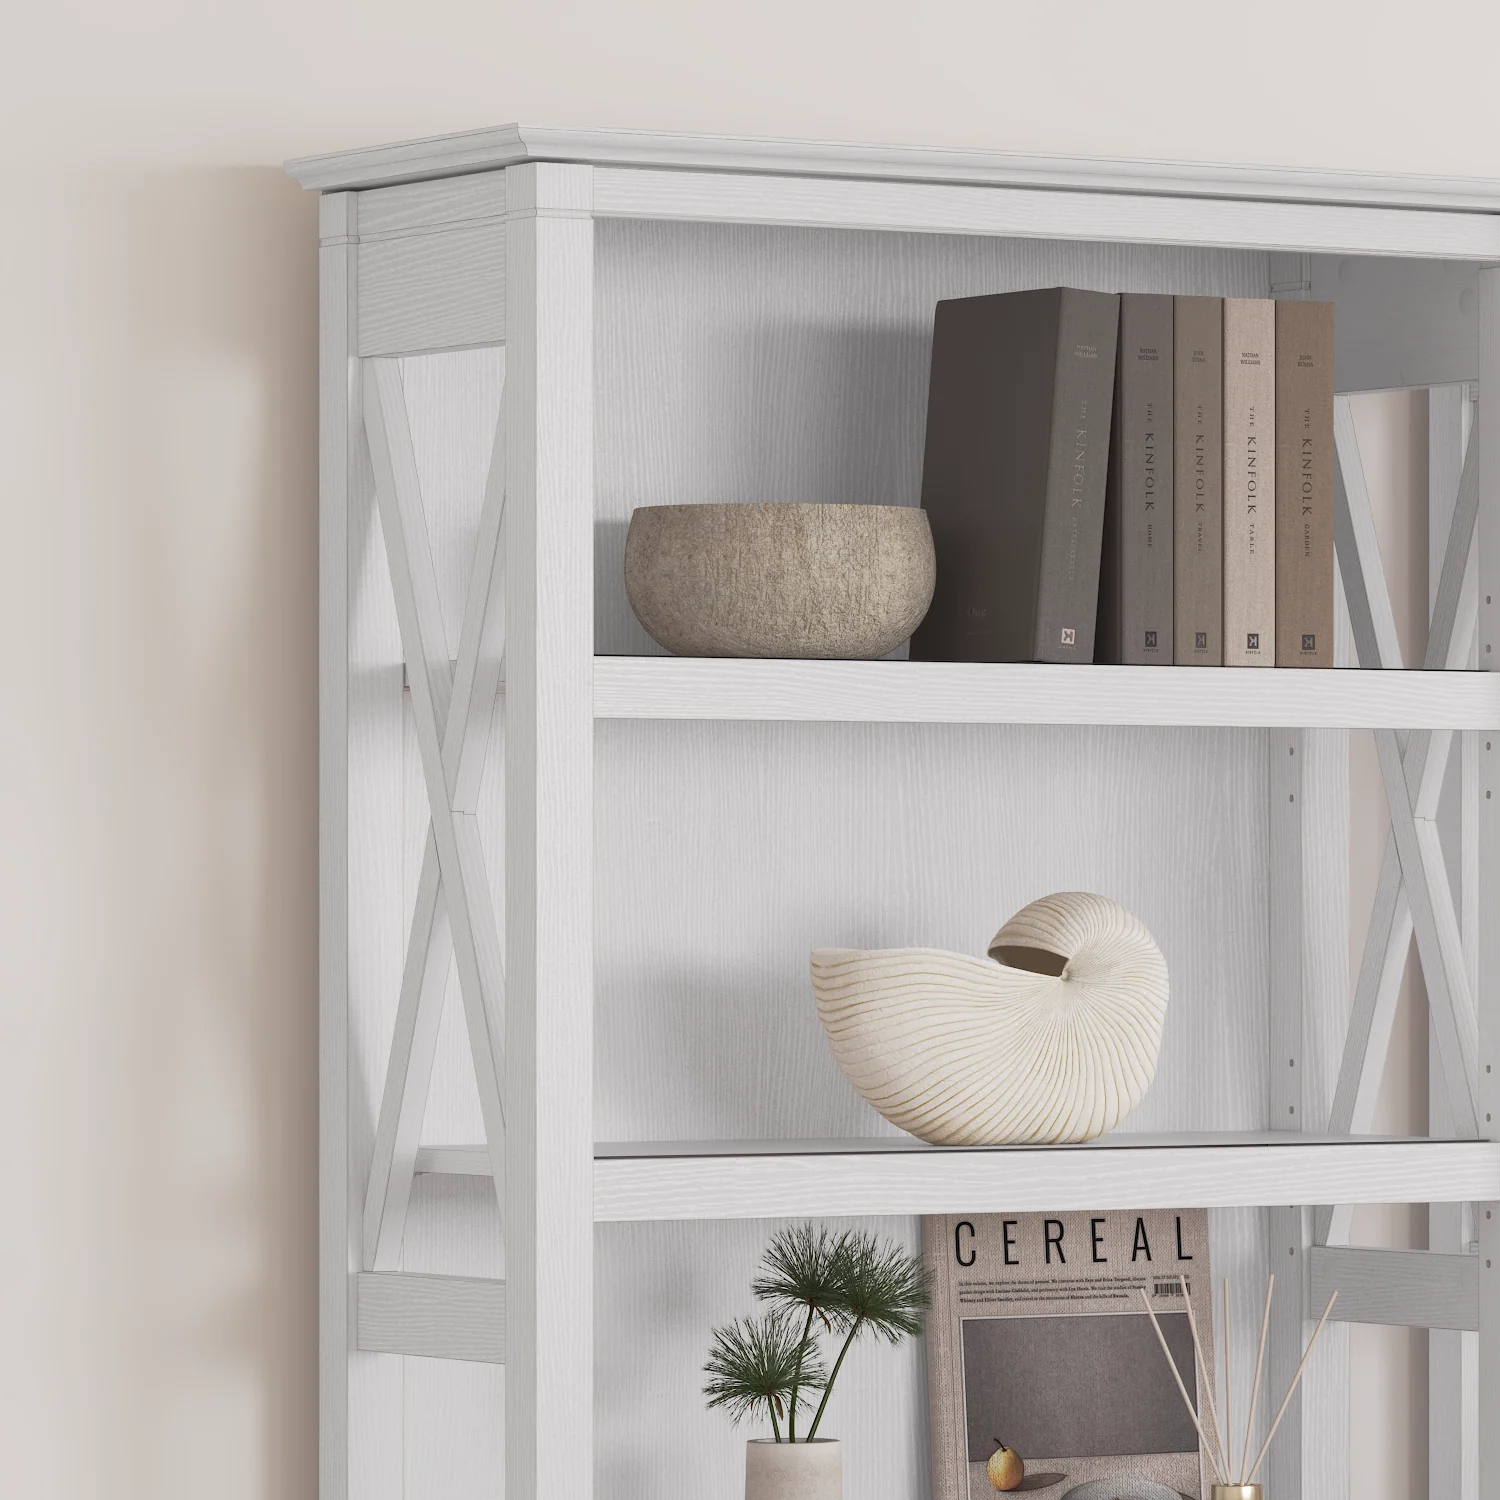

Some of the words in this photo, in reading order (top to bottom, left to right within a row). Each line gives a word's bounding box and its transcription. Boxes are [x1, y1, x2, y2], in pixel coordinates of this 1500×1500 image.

[1071, 429, 1088, 509] KINFOLK
[1145, 432, 1155, 512] KINFOLK
[1195, 434, 1205, 513] KINFOLK
[1247, 436, 1257, 515] KINFOLK
[1302, 438, 1313, 517] KINFOLK
[954, 1215, 1193, 1267] CEREAL
